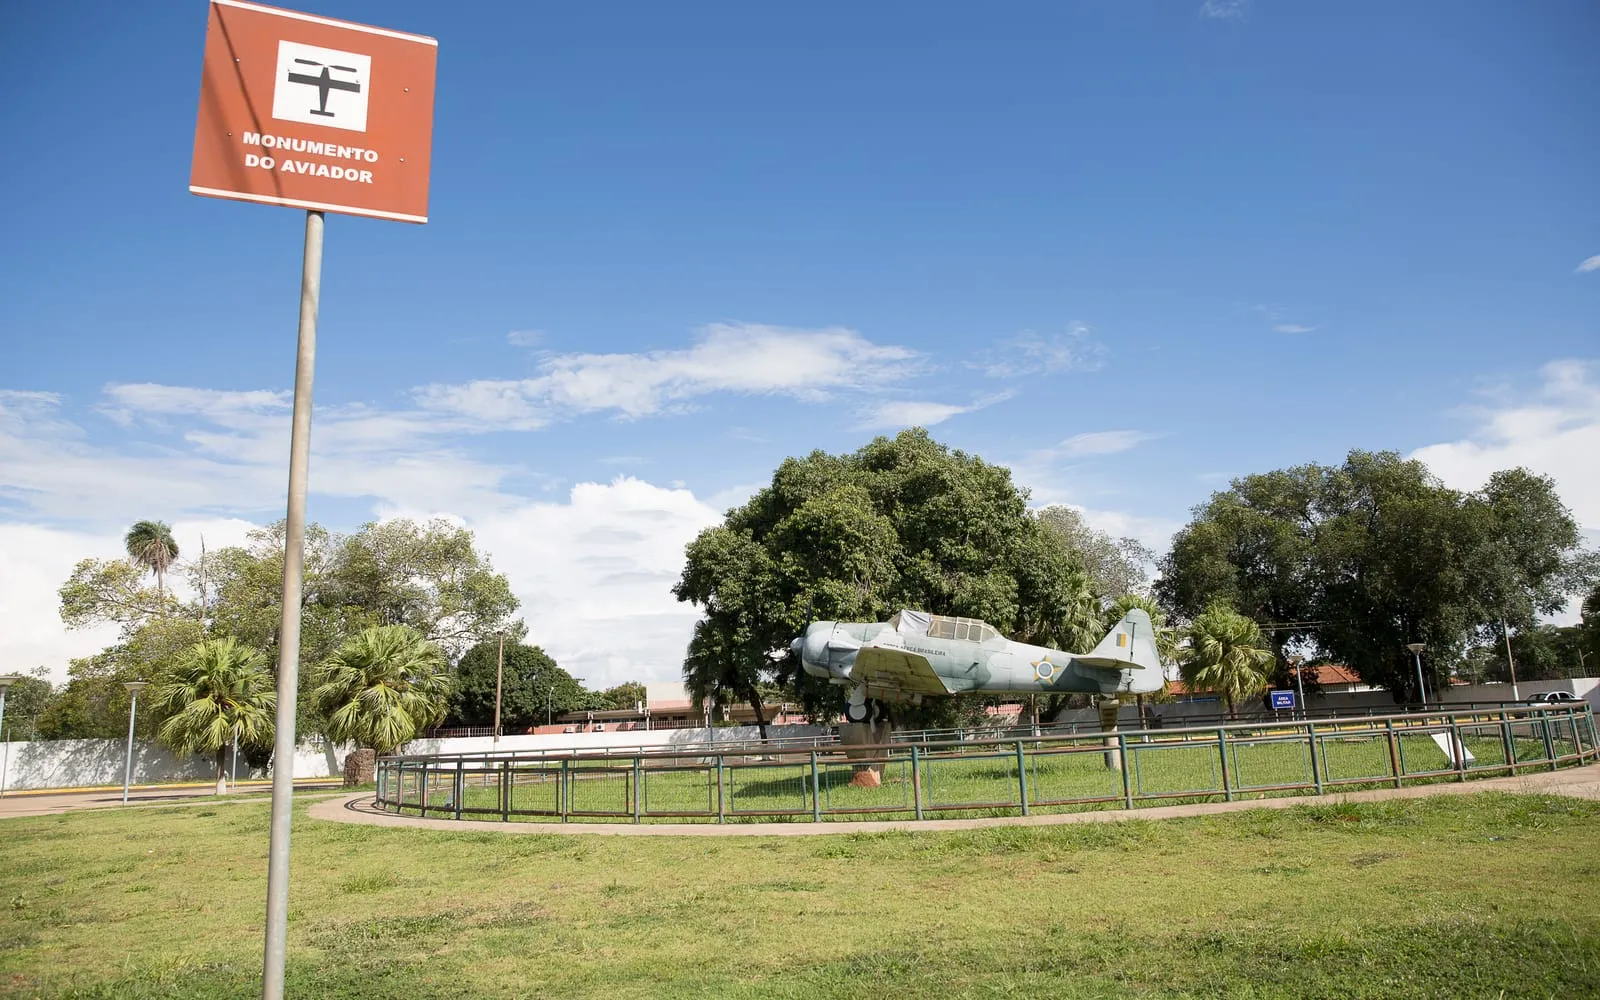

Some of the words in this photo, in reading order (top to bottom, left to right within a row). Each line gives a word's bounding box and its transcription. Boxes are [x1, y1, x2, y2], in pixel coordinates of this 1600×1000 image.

[243, 131, 379, 163] MONUMENTO
[245, 153, 275, 170] DO
[280, 159, 373, 184] AVIADOR
